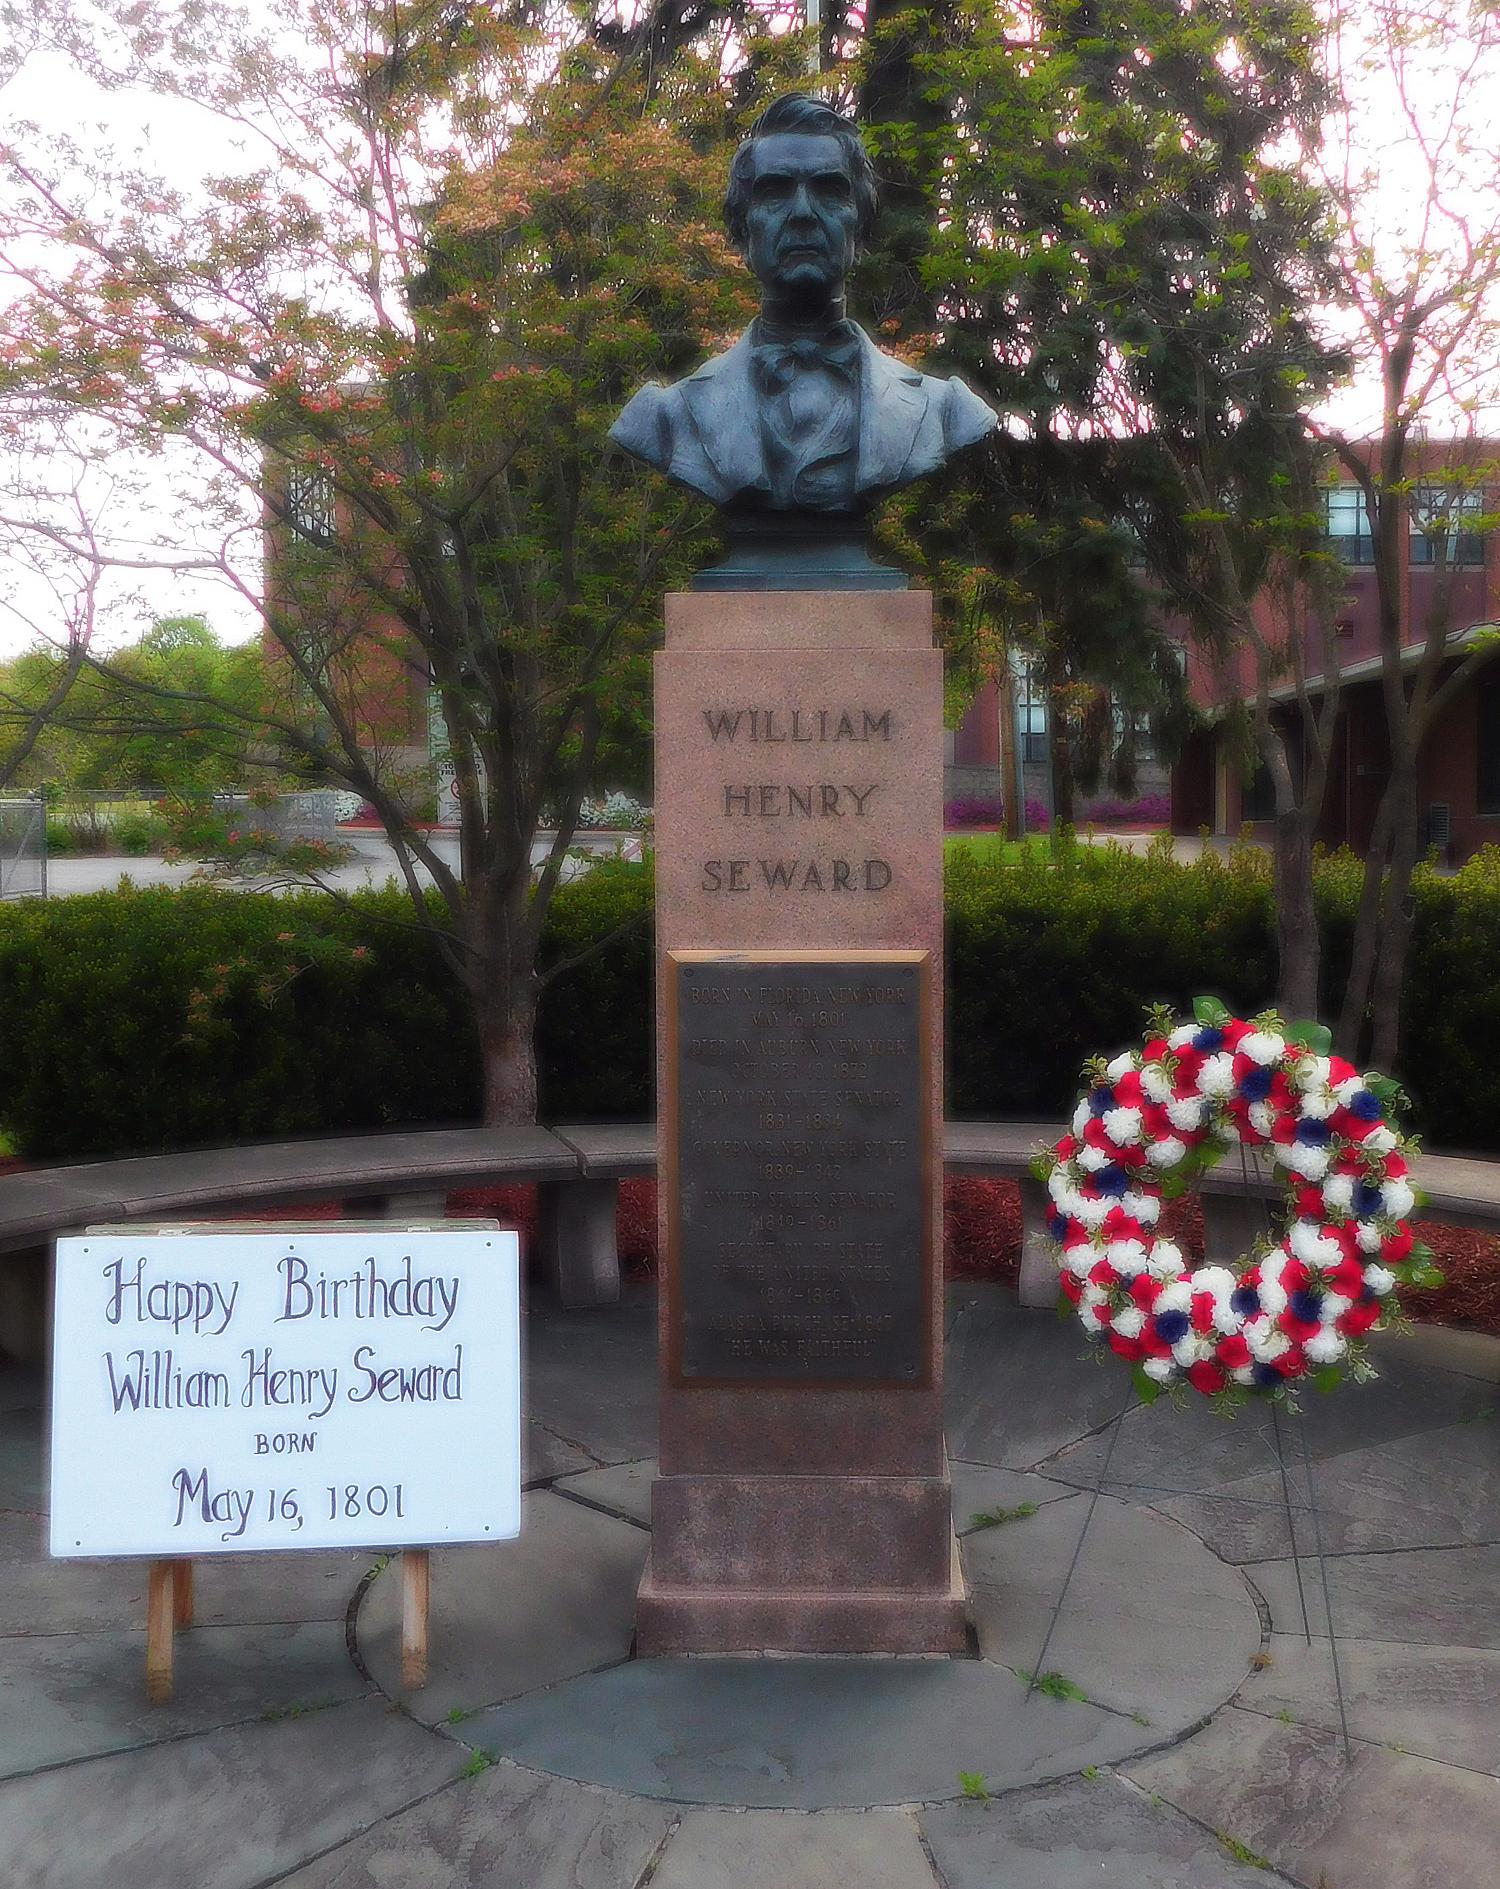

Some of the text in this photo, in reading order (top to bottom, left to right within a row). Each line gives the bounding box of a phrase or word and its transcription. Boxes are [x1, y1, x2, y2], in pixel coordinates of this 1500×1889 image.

[702, 709, 892, 742] WILLIAM
[723, 784, 879, 817] HENRY
[701, 859, 892, 892] SEWARD
[691, 986, 731, 1004] BORN
[737, 986, 752, 1003] IN
[864, 986, 906, 1004] YORK
[812, 1010, 847, 1027] 1801
[102, 1256, 460, 1337] Happy Birthday
[102, 1343, 464, 1420] William Henry Seward
[253, 1431, 318, 1456] BORN
[172, 1467, 405, 1542] May 16, 1801
